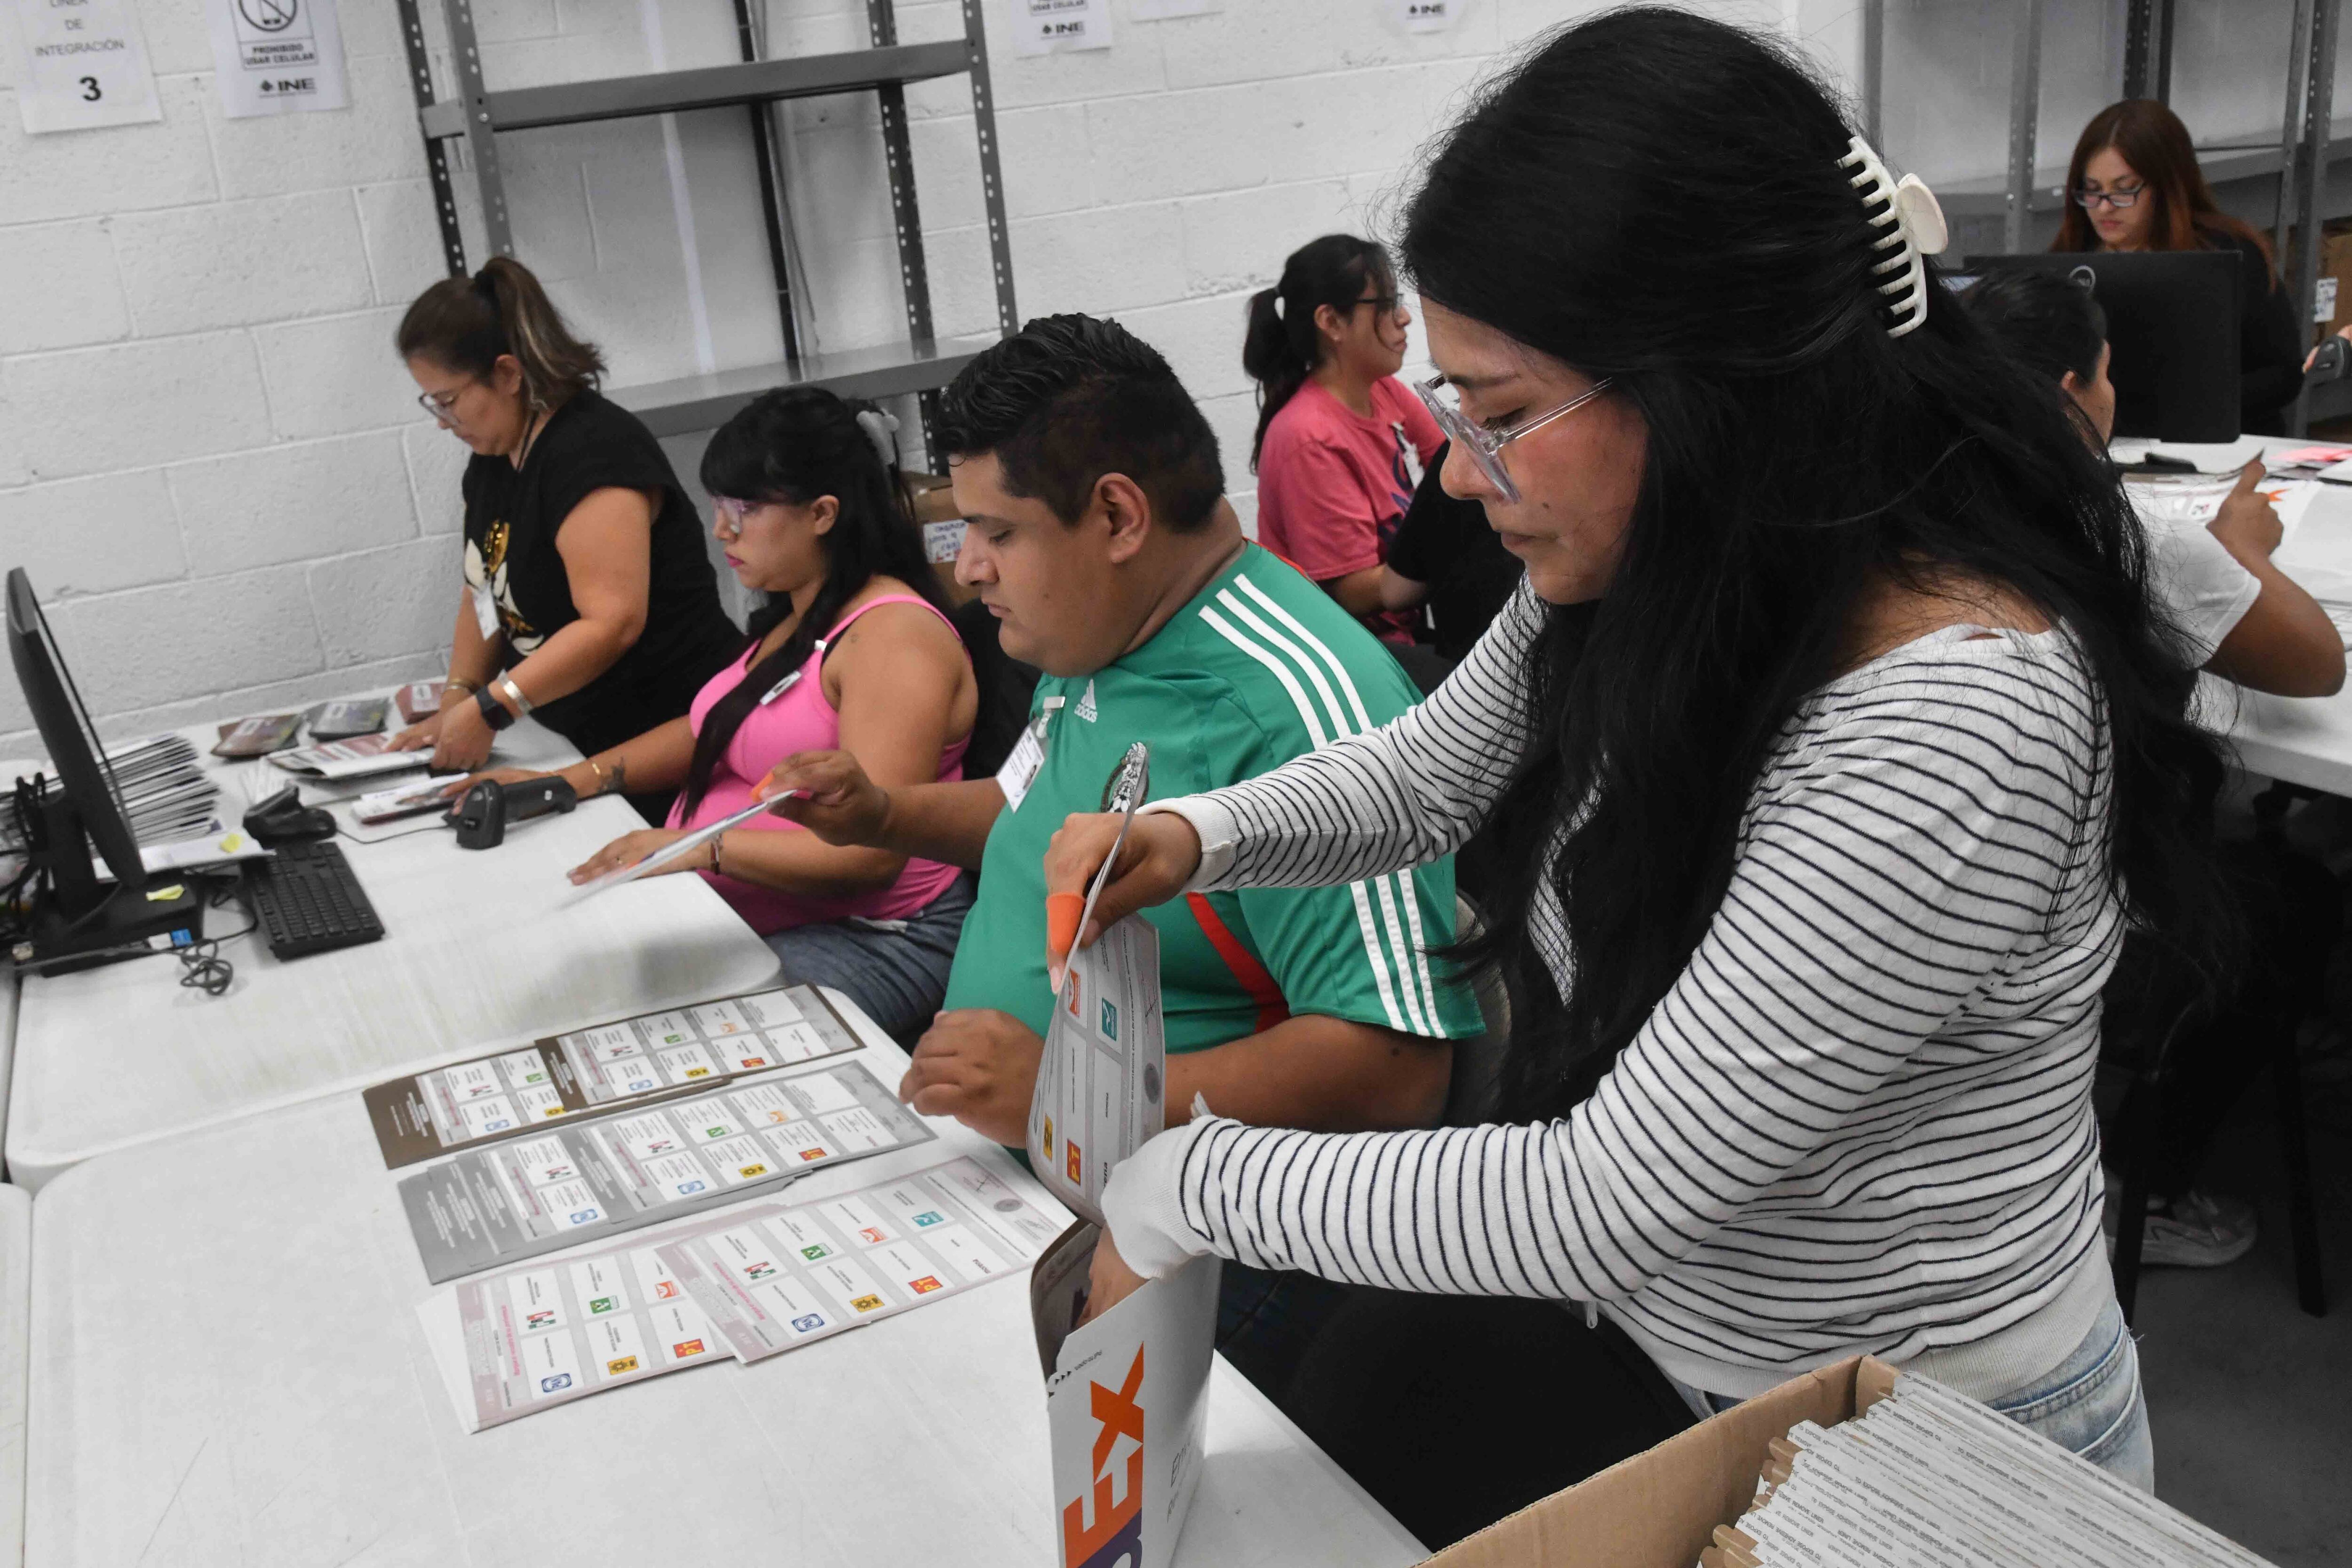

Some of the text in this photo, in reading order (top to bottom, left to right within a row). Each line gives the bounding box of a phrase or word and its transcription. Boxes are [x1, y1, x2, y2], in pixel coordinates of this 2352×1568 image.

[65, 18, 83, 30] DE
[35, 39, 124, 56] INTEGRACIÓN
[79, 76, 102, 101] 3
[278, 79, 314, 91] INE
[1074, 704, 1097, 723] adidas
[918, 1277, 940, 1291] PT
[1814, 1452, 1833, 1466] EXPOSE
[1833, 1463, 1842, 1472] TO
[1862, 1481, 1881, 1495] EXPOSE
[1792, 1499, 1811, 1515] REMOVE
[1810, 1511, 1825, 1524] LINER
[1745, 1521, 1762, 1536] EXPOSE
[1756, 1514, 1775, 1530] REMOVE
[1781, 1513, 1814, 1538] REMOVE LINER
[1774, 1526, 1796, 1544] ADHESIVE
[1836, 1528, 1852, 1542] LINER
[1796, 1540, 1815, 1556] EXPOSE
[1851, 1537, 1872, 1554] REMOVE
[1779, 1549, 1796, 1564] EXPOSE
[1814, 1552, 1823, 1561] TO
